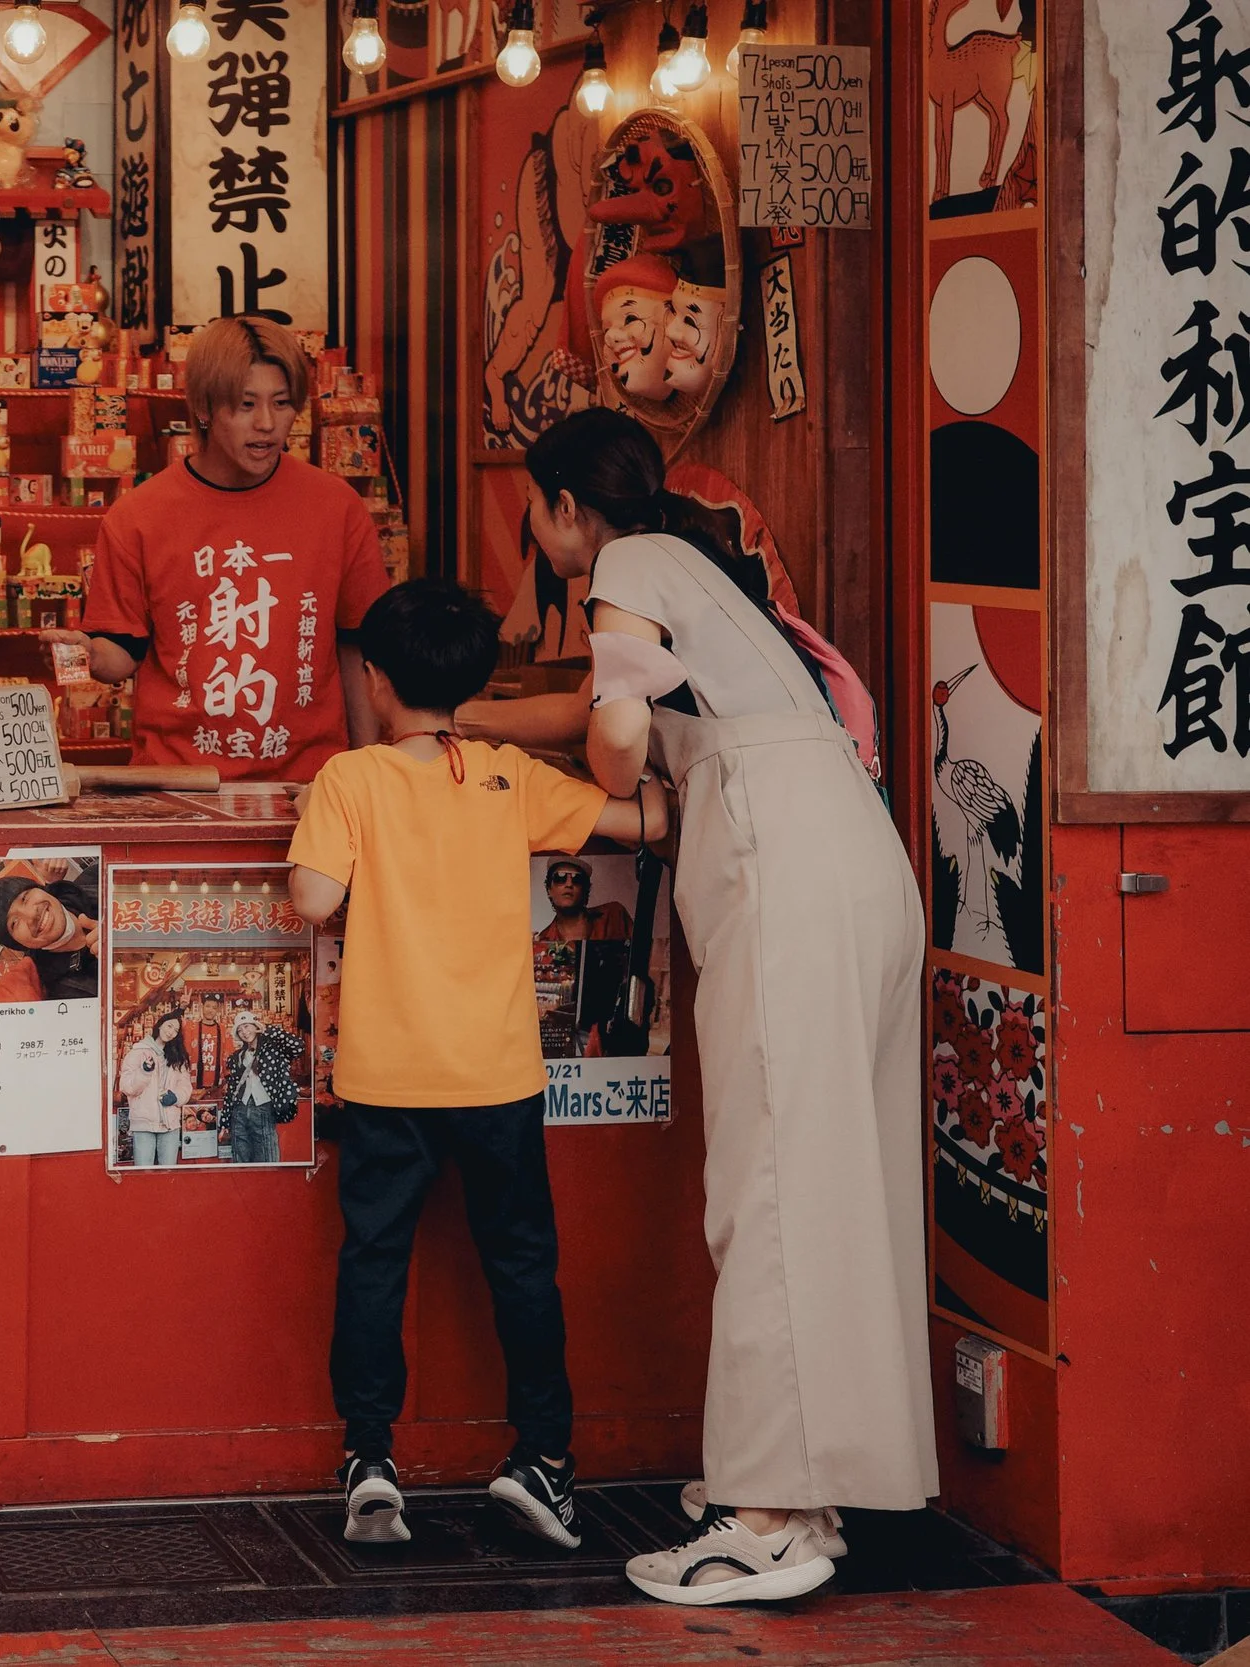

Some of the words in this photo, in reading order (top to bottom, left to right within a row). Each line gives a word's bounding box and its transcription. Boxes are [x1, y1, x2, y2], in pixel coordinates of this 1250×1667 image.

[761, 74, 792, 89] Shots
[770, 161, 792, 183] 发
[766, 265, 797, 410] 大当たり
[194, 541, 293, 578] 日本一
[203, 577, 279, 727] 射的
[294, 591, 318, 708] 元祖新世界
[193, 725, 291, 760] 秘宝館
[544, 1075, 670, 1118] Marsご来店
